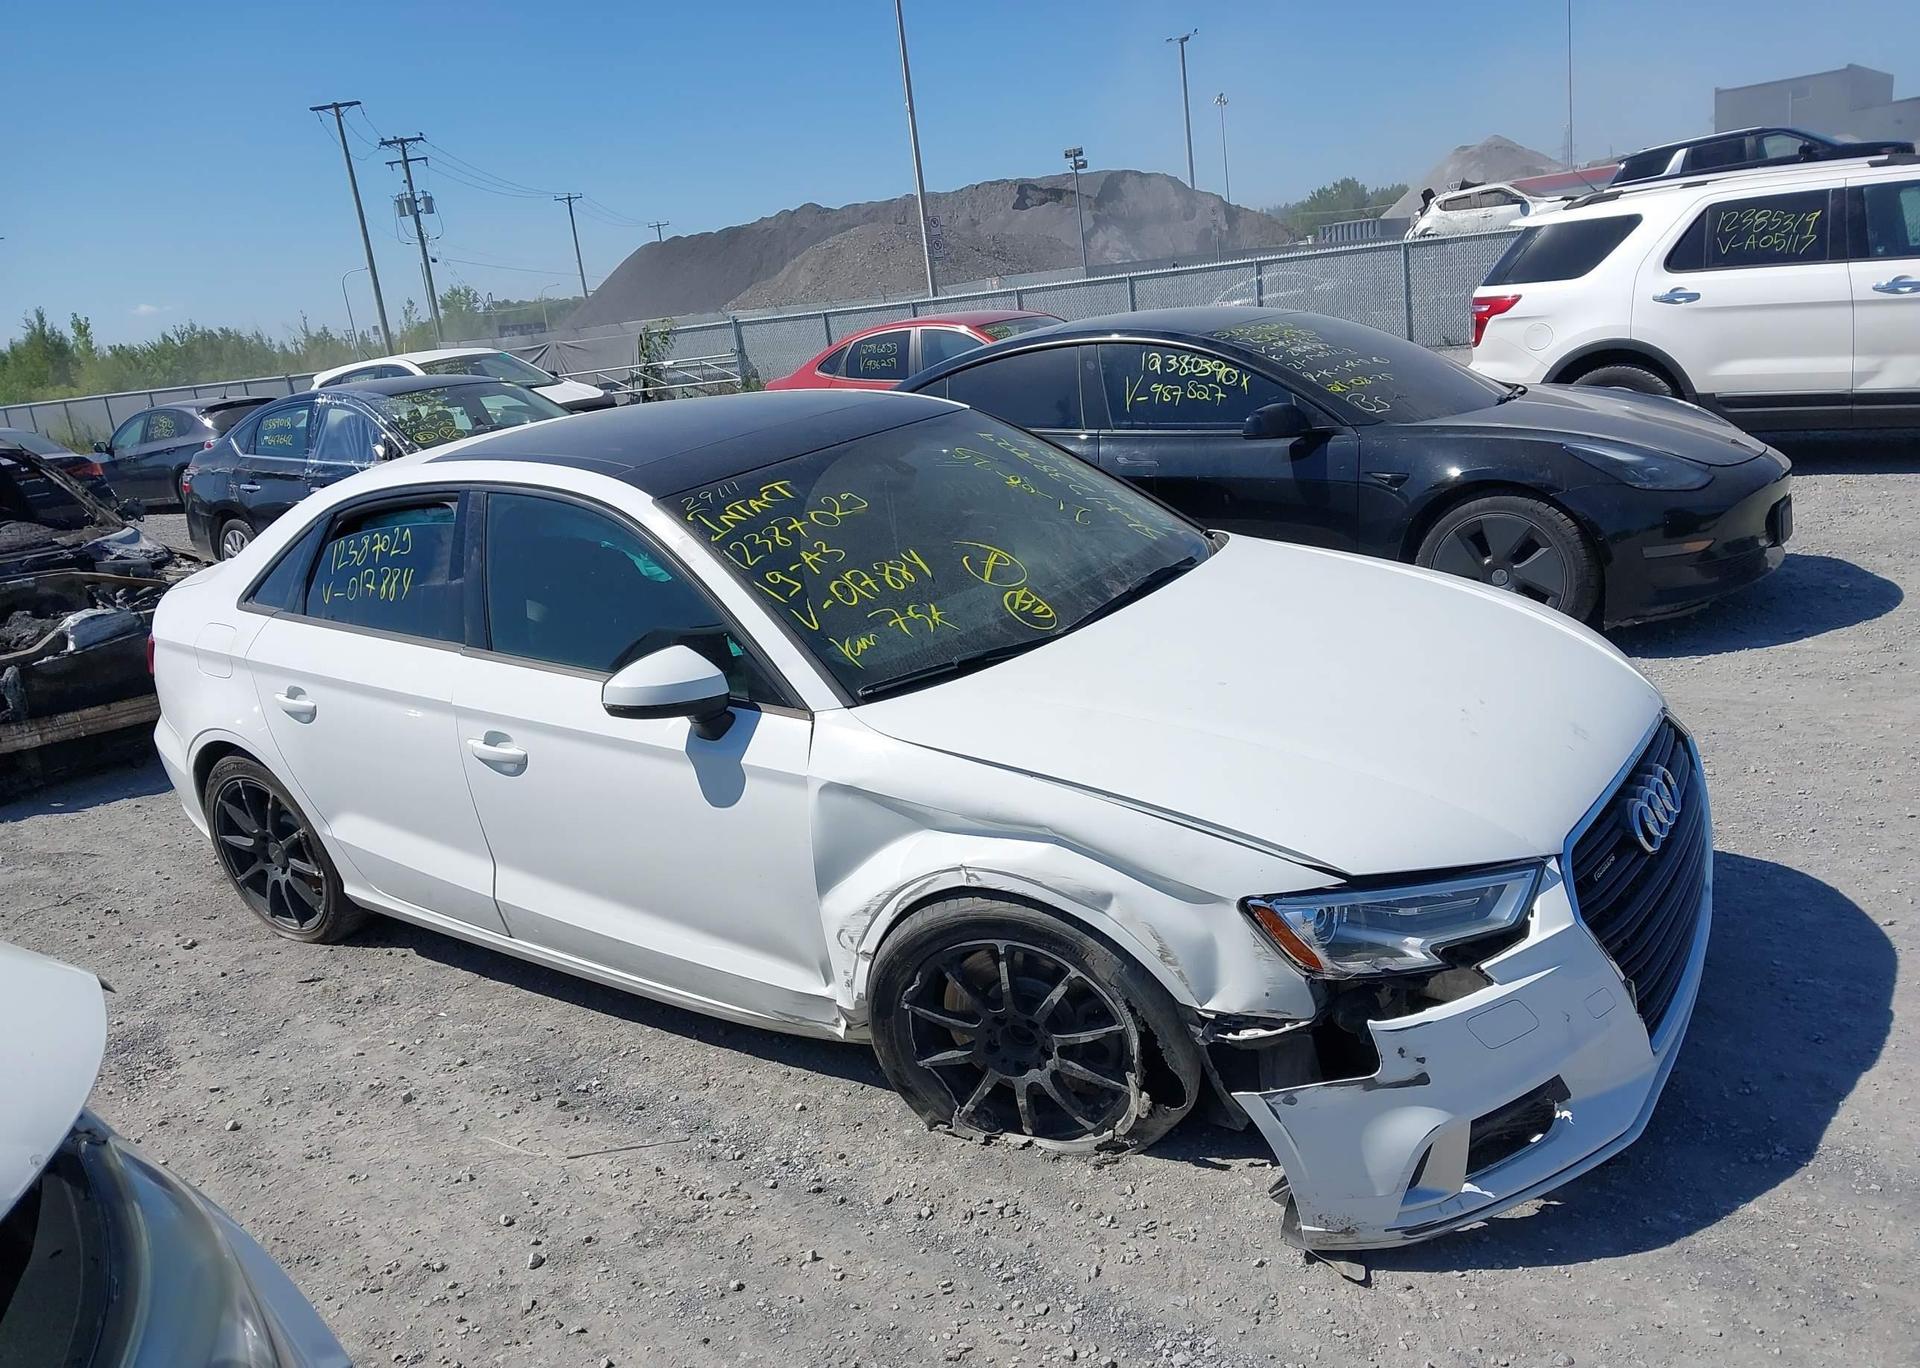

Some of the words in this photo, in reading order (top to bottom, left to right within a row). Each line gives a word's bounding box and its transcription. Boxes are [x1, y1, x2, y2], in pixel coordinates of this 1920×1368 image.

[1716, 208, 1822, 236] 12385319
[1126, 375, 1227, 413] V-987827
[687, 480, 795, 541] INTACT
[723, 492, 869, 570] 12387029
[331, 527, 412, 575] 12387029
[754, 541, 846, 603] 19-A3
[322, 567, 415, 604] V-017884
